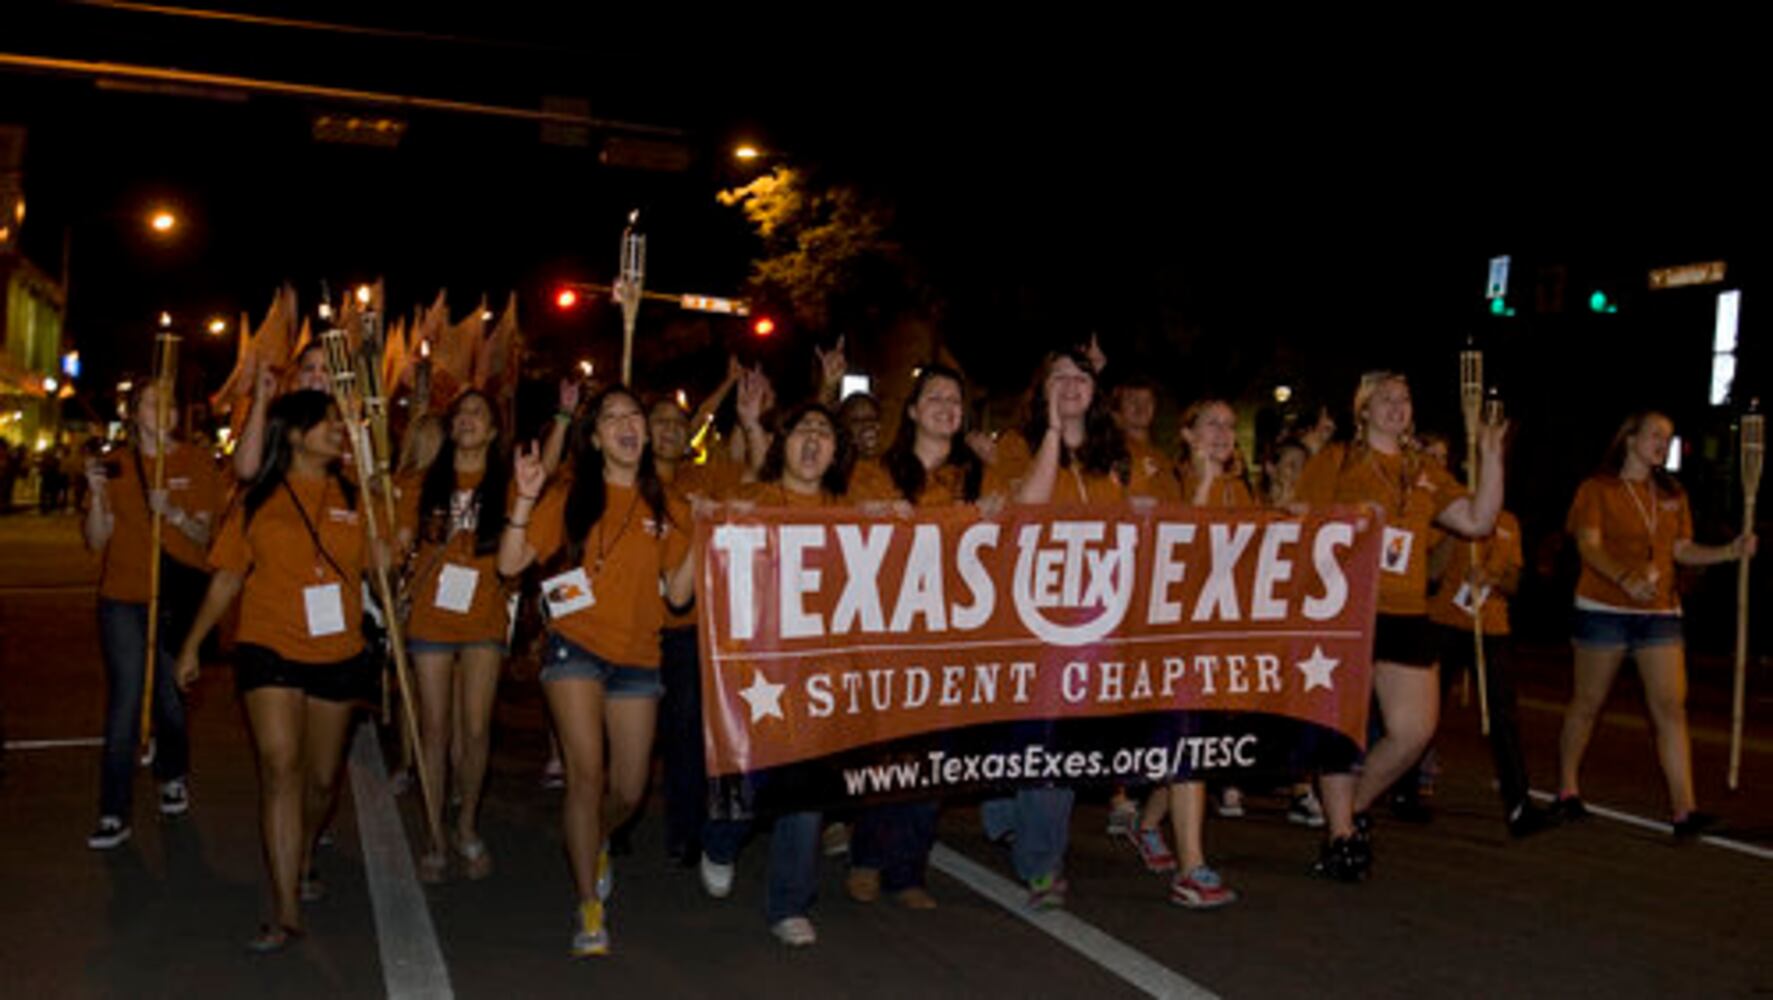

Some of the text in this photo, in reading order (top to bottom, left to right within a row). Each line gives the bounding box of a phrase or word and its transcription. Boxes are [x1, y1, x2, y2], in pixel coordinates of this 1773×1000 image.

[714, 523, 997, 639] TEXAS
[1147, 523, 1353, 625] EXES
[806, 654, 1283, 718] STUDENT CHAPTER
[845, 735, 1257, 796] www.TexasExes.org/TESC
